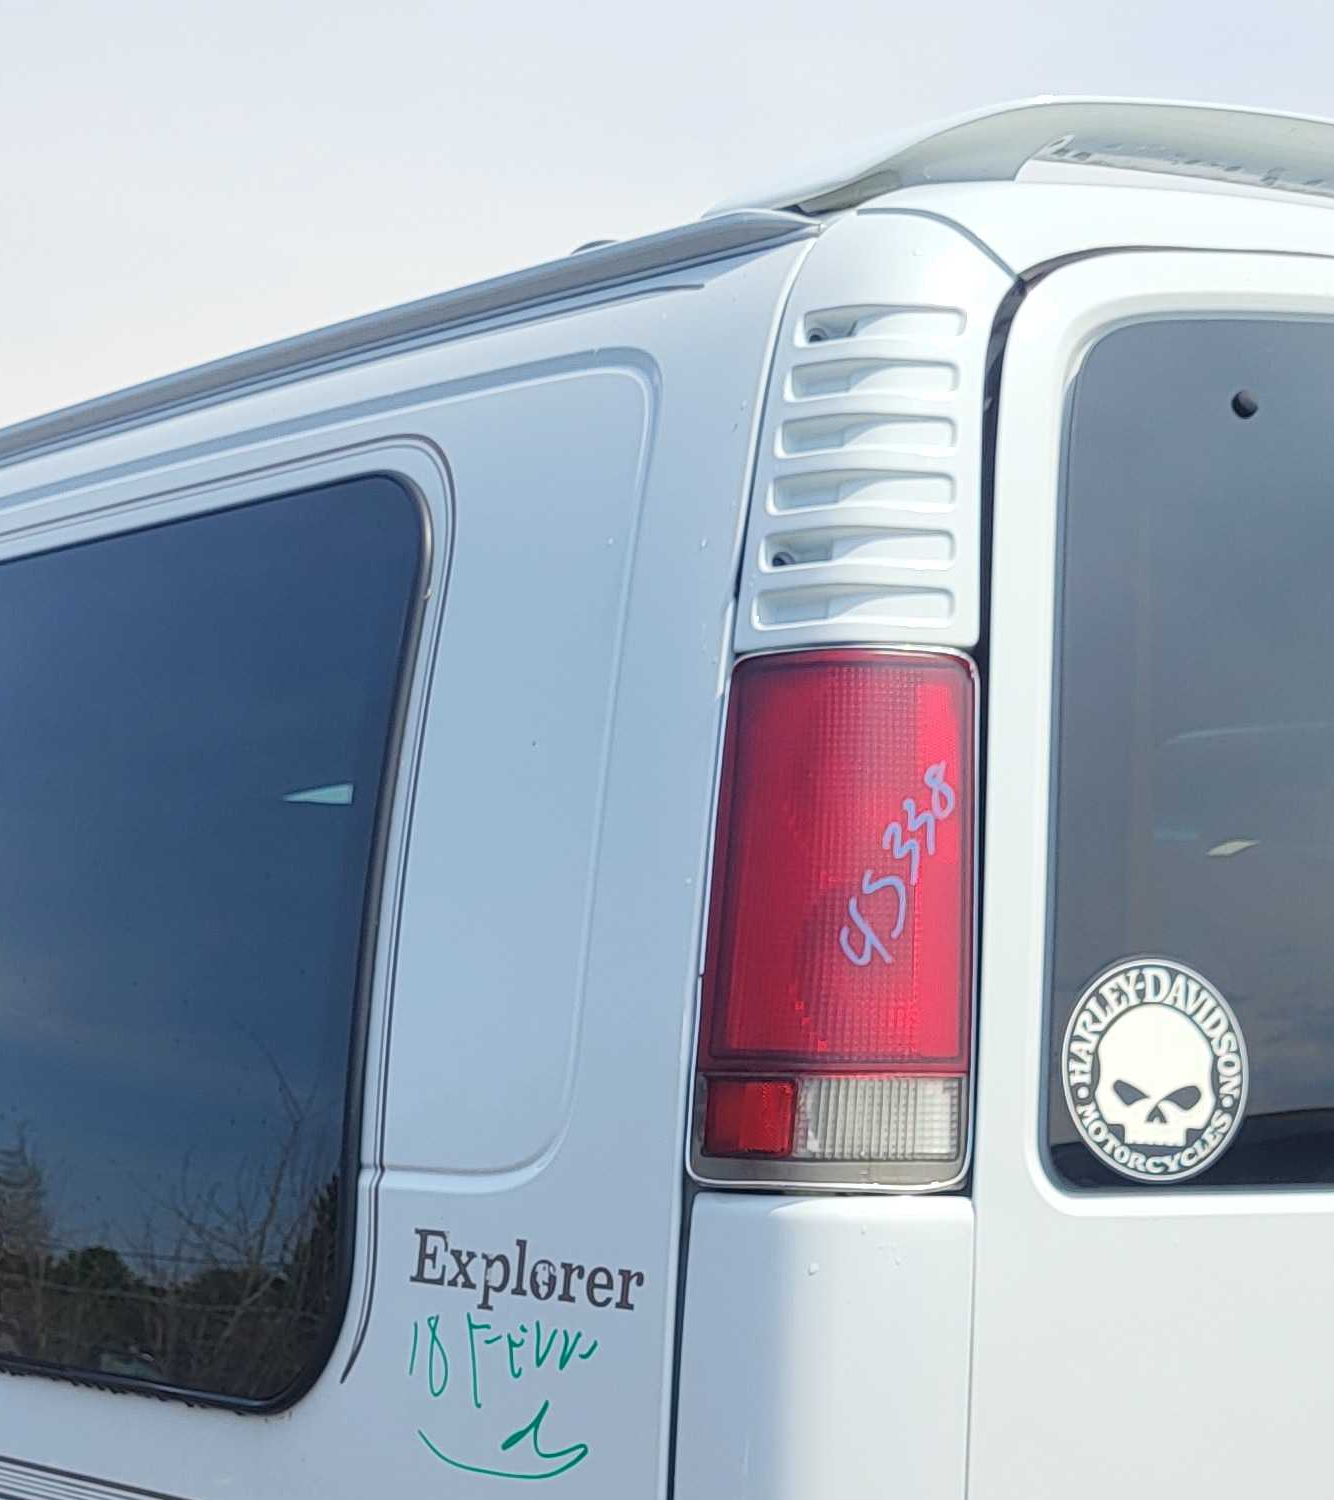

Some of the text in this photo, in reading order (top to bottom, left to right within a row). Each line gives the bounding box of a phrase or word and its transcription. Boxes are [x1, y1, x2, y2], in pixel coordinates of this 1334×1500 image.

[839, 760, 956, 966] 45338
[1067, 966, 1243, 1100] HARLEY-DAVIDSON
[1077, 1102, 1233, 1174] MOTORCYCLES
[409, 1227, 646, 1311] Explorer
